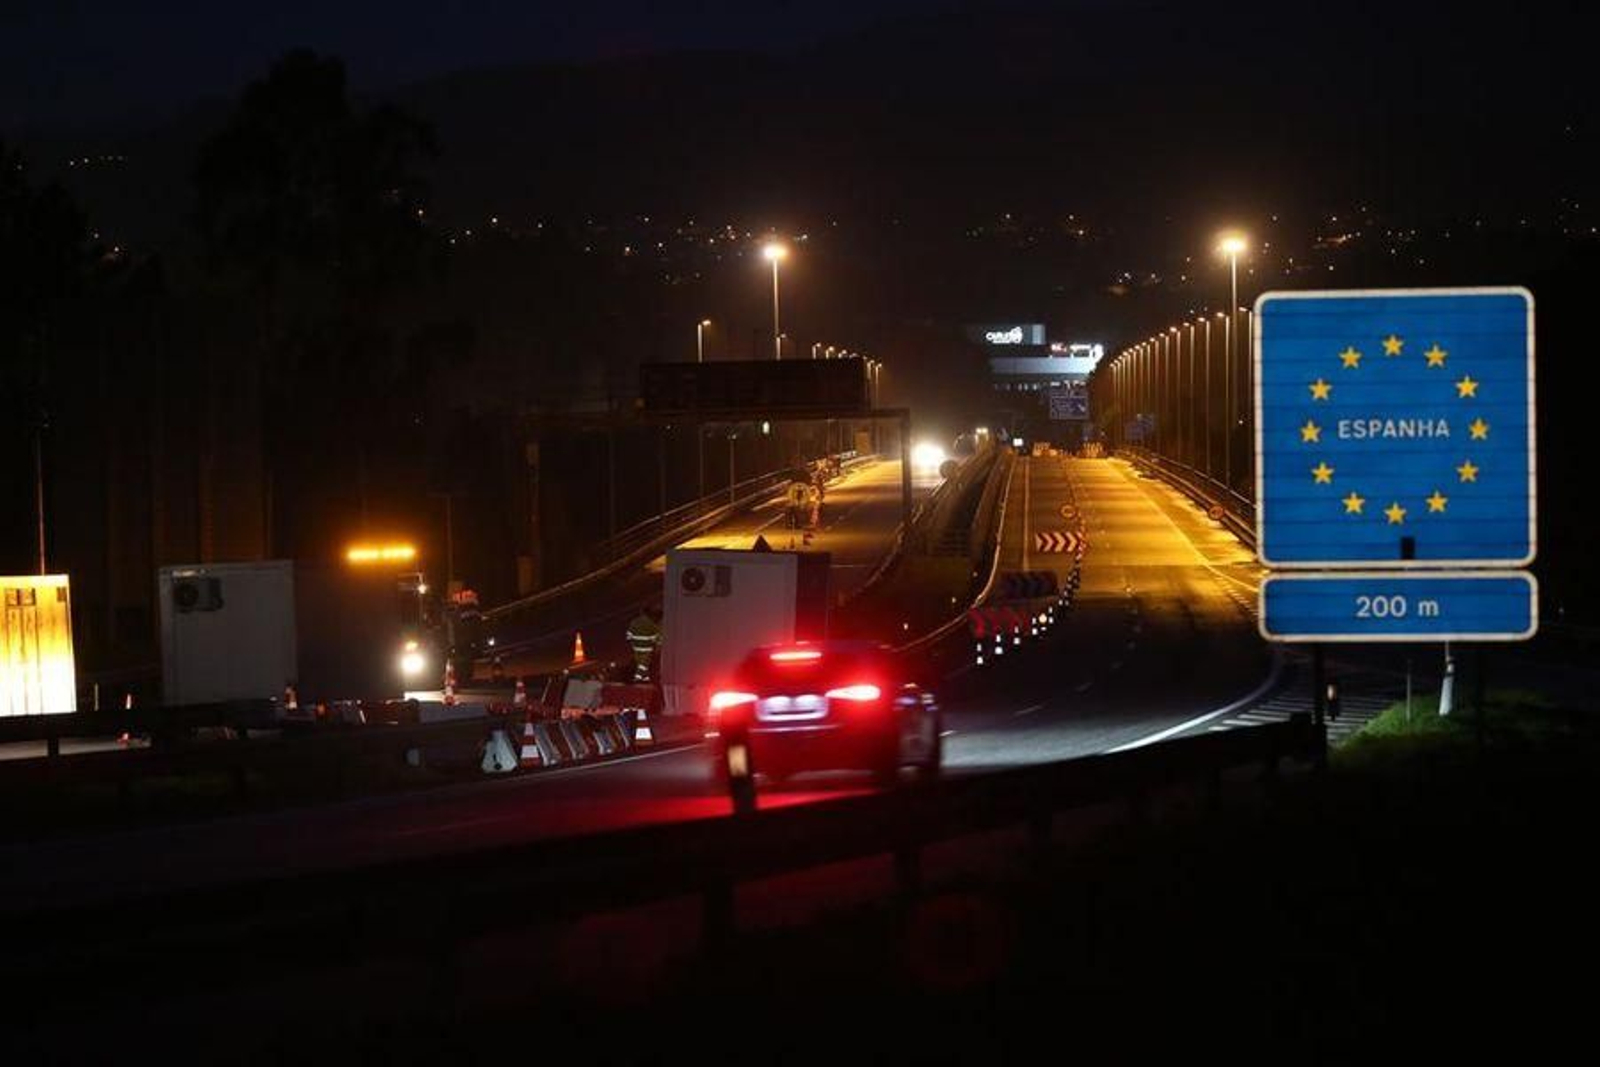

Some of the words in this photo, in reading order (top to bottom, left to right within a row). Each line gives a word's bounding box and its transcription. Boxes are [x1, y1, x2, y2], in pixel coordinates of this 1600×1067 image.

[1338, 419, 1450, 438] ESPANHA
[1356, 596, 1407, 618] 200
[1418, 601, 1439, 617] m
